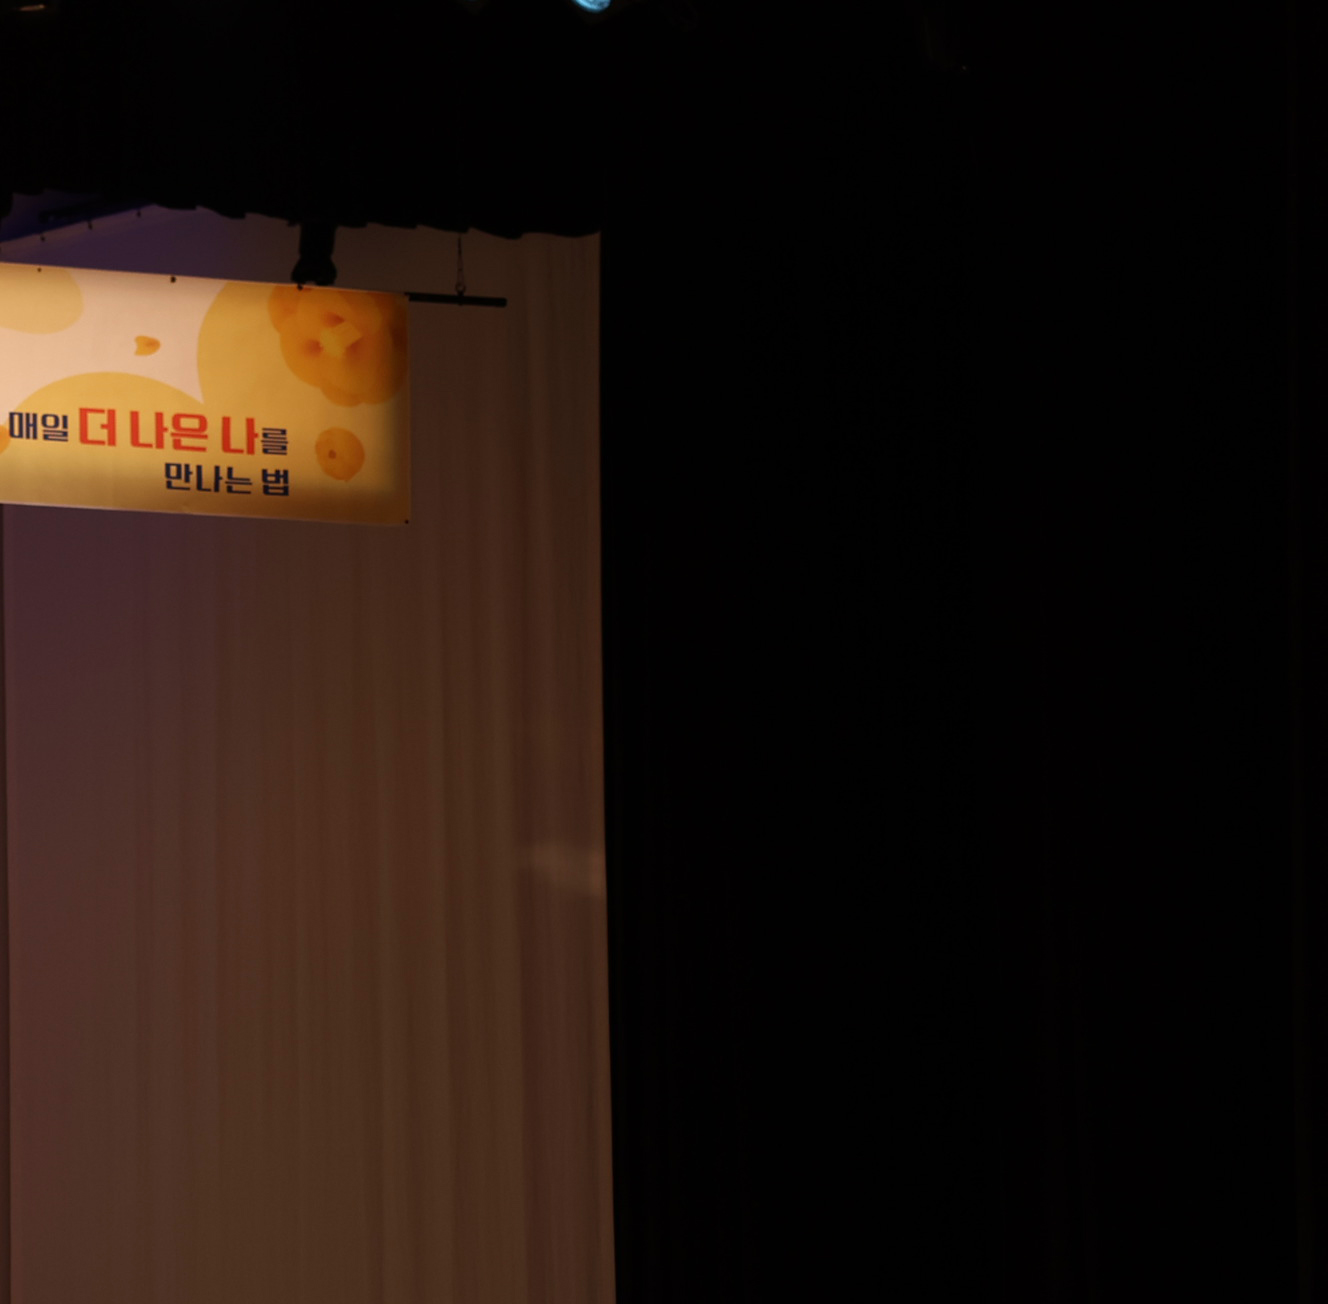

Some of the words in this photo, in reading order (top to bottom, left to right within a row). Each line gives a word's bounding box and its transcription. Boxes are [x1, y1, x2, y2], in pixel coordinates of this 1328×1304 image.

[7, 410, 69, 443] 매일
[78, 407, 117, 447] 더
[129, 410, 209, 452] 나은
[220, 416, 290, 456] 나를
[164, 461, 253, 496] 만나는
[261, 468, 290, 497] 법
